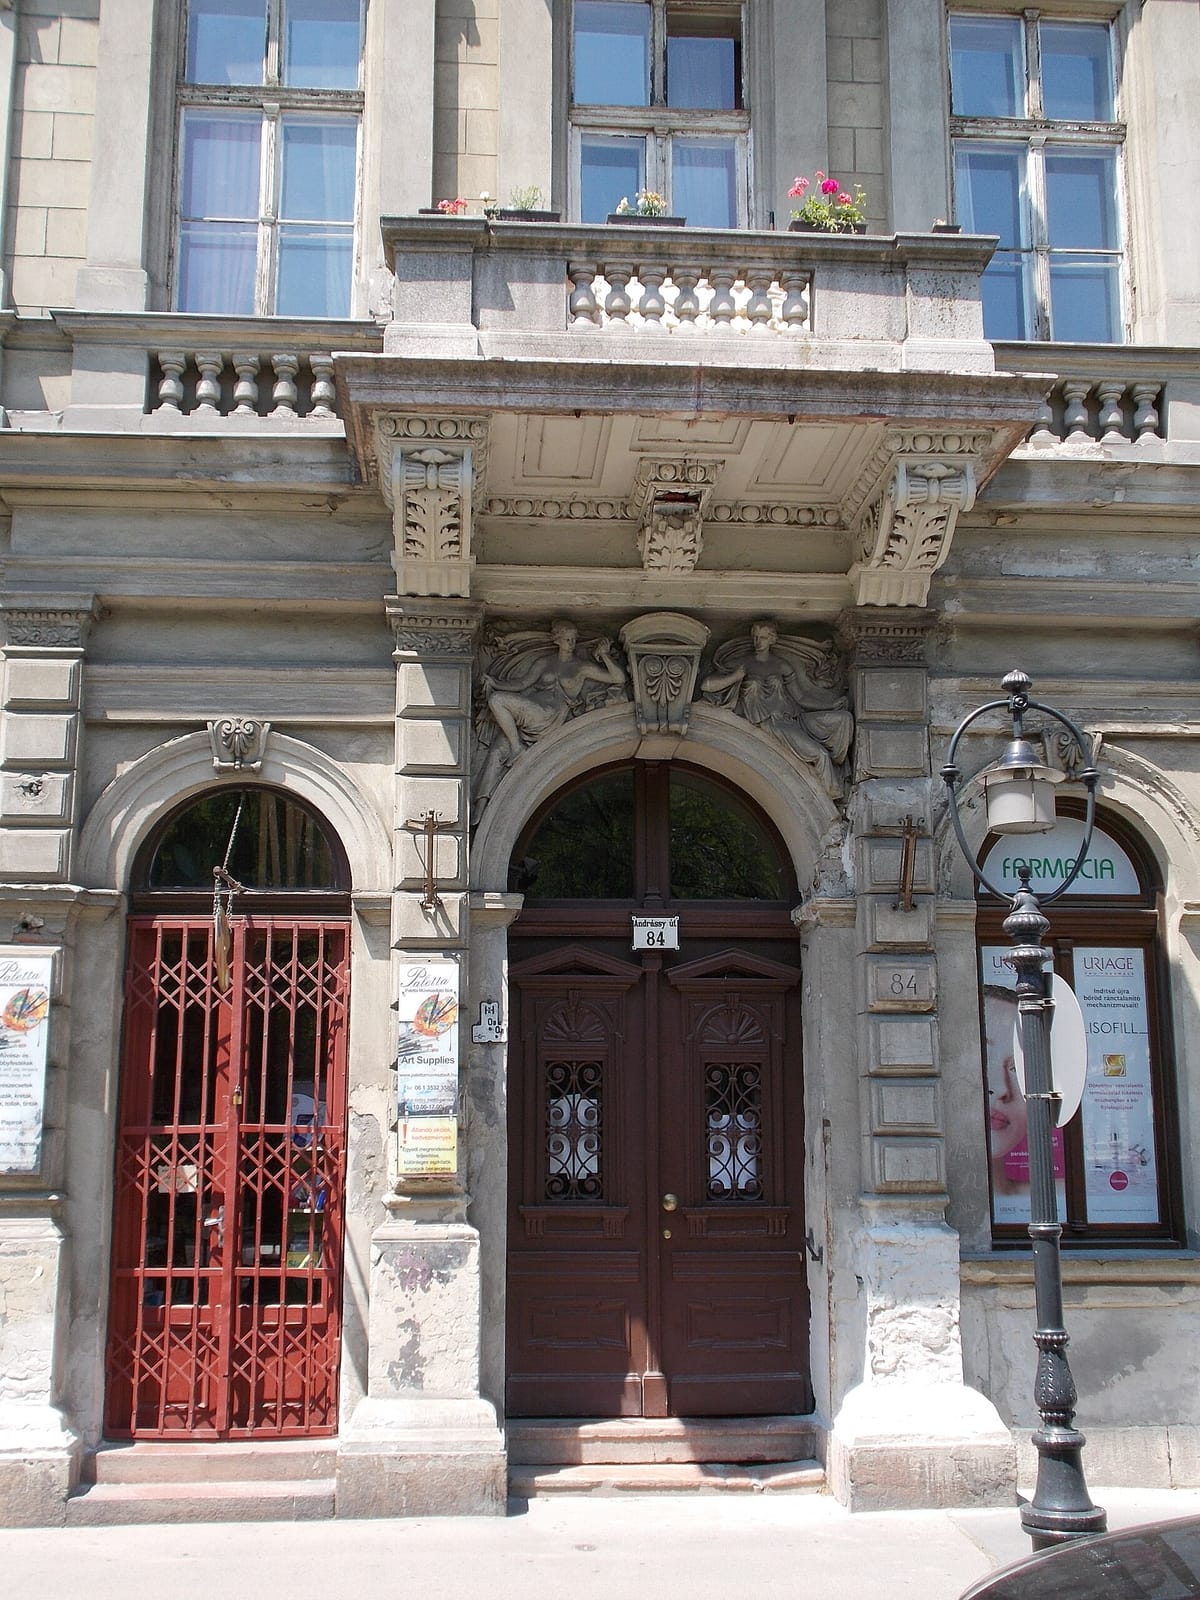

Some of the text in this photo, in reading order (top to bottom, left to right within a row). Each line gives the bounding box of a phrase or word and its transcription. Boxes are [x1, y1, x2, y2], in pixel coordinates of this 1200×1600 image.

[1003, 857, 1114, 879] FARMACIA
[634, 919, 666, 930] Andrássy
[647, 931, 665, 946] 84
[1083, 957, 1134, 971] URIAGE
[400, 966, 449, 987] Paletta
[891, 973, 917, 995] 84
[401, 1056, 455, 1066] Art Supplies
